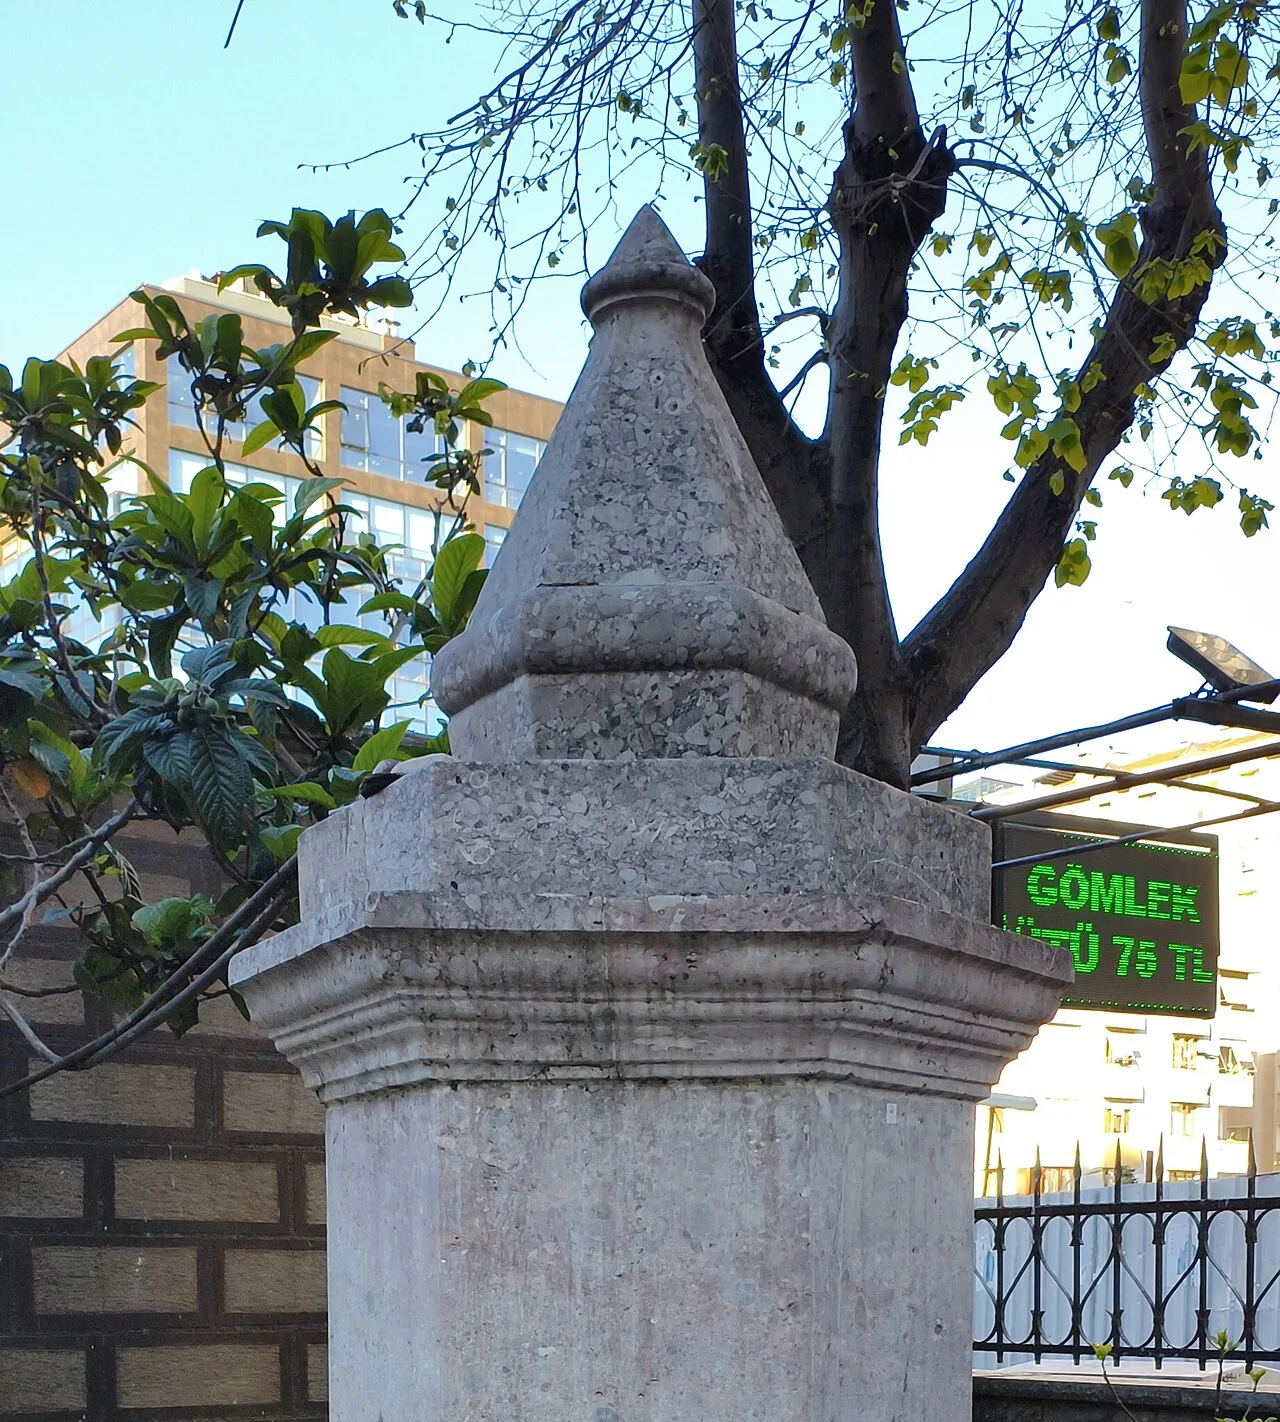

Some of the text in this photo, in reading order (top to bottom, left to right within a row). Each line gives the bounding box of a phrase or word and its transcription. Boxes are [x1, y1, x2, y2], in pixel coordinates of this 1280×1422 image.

[1026, 863, 1201, 924] GÖMLEK
[1112, 935, 1158, 979] 75
[1168, 943, 1214, 984] TL
